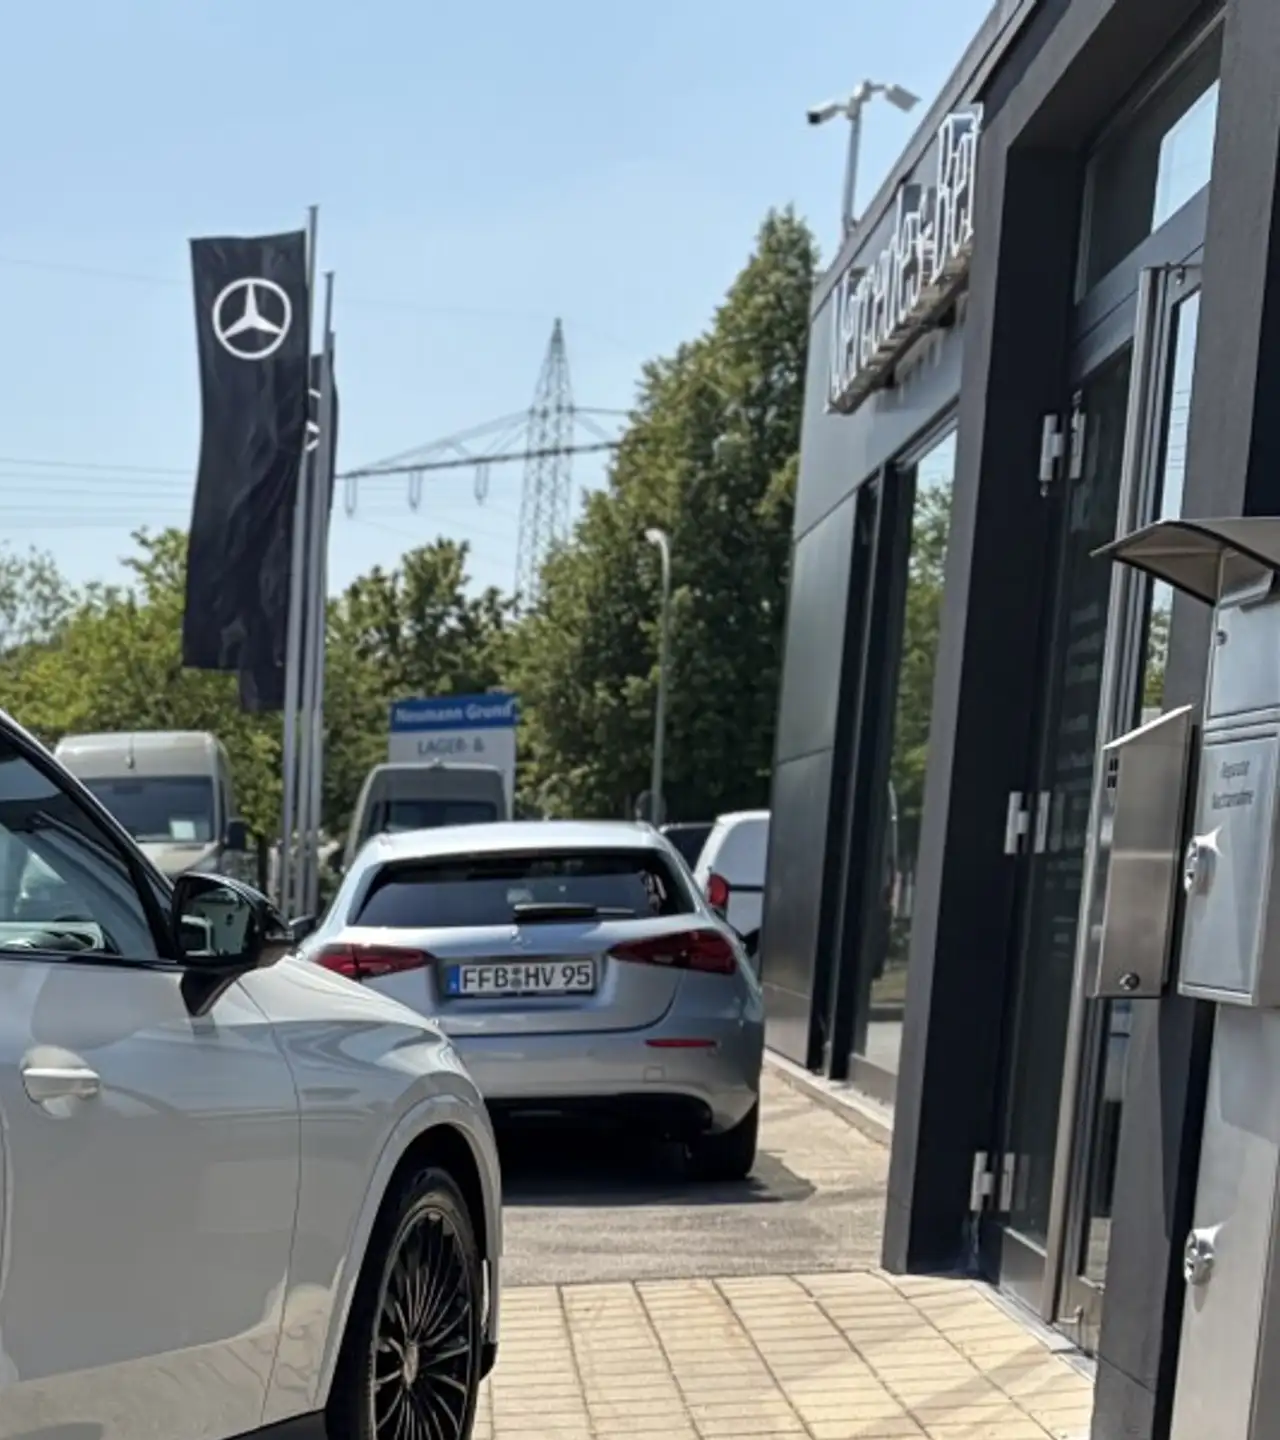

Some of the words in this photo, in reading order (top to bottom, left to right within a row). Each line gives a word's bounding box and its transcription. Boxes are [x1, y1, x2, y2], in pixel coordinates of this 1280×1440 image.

[463, 967, 508, 990] FFB
[524, 966, 555, 987] HV
[561, 964, 591, 986] 95
